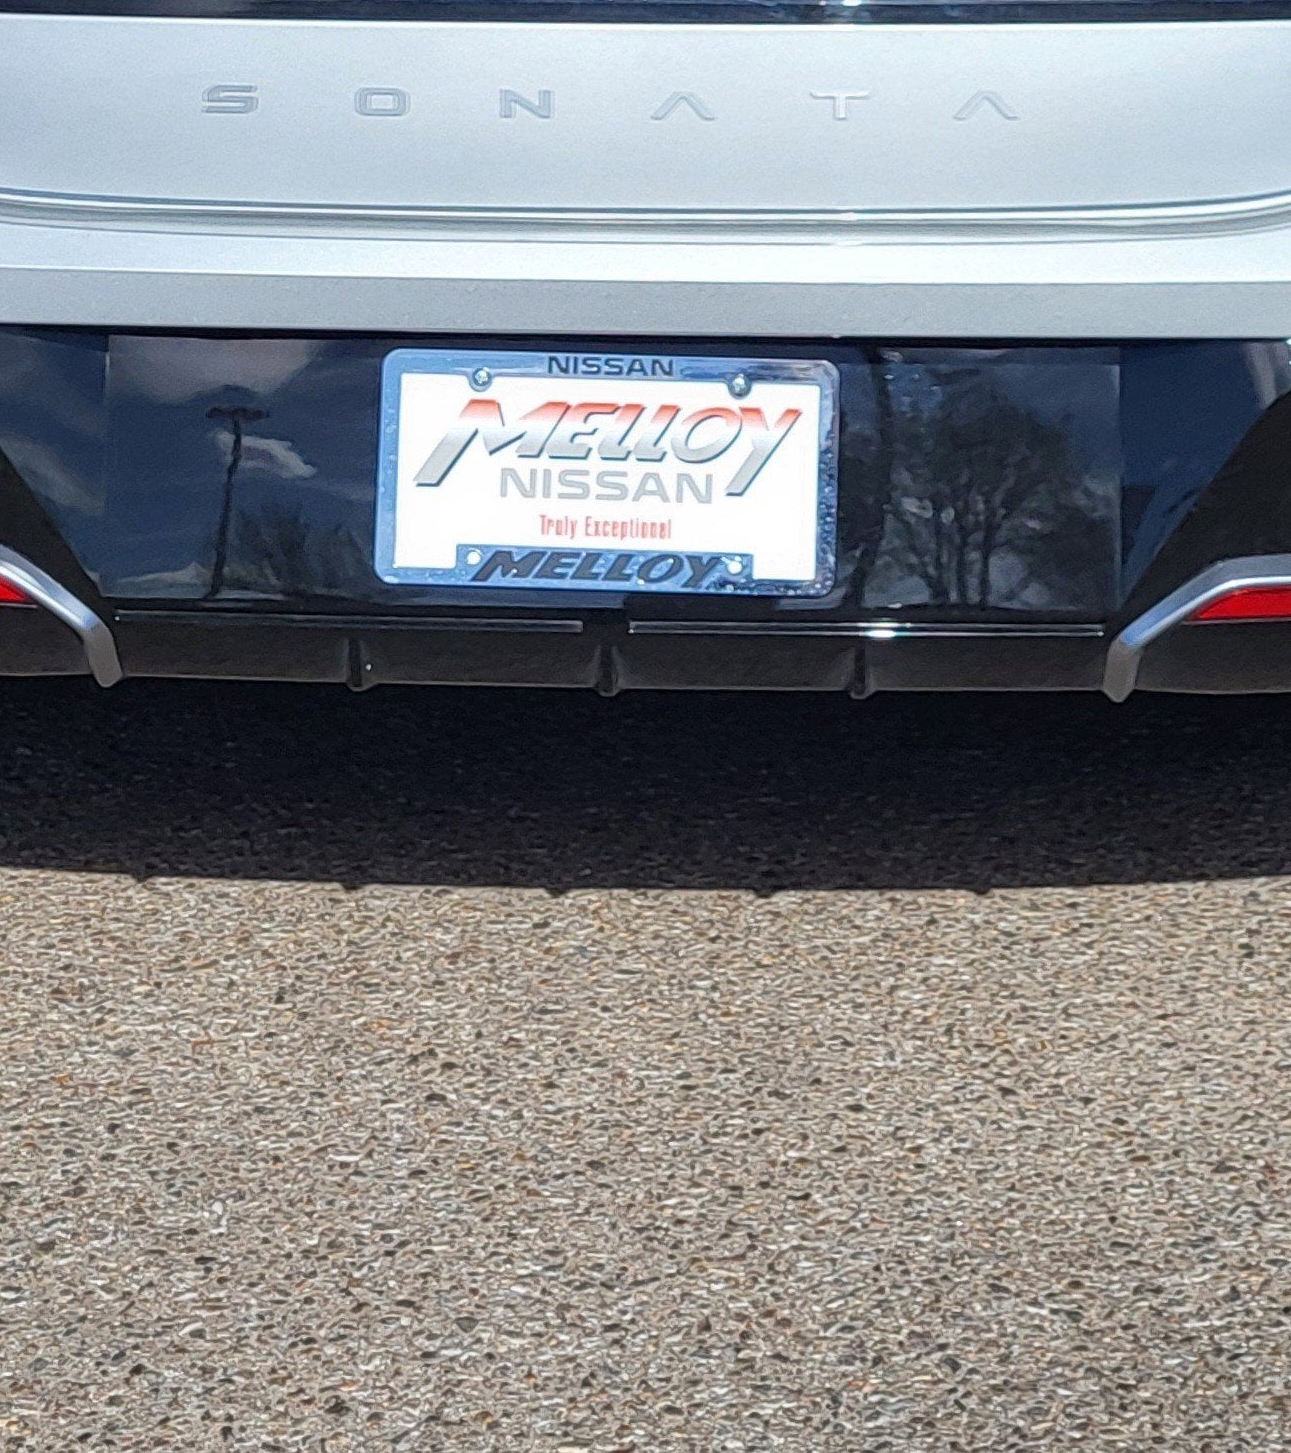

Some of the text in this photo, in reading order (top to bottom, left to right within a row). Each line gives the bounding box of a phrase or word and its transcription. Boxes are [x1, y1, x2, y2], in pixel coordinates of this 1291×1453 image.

[200, 84, 1020, 122] SONATA
[546, 354, 675, 378] NISSAN
[413, 398, 802, 497] MELLOY
[499, 467, 714, 504] NISSAN
[539, 513, 673, 541] Truly Exceptional
[470, 549, 723, 589] MELLOY
